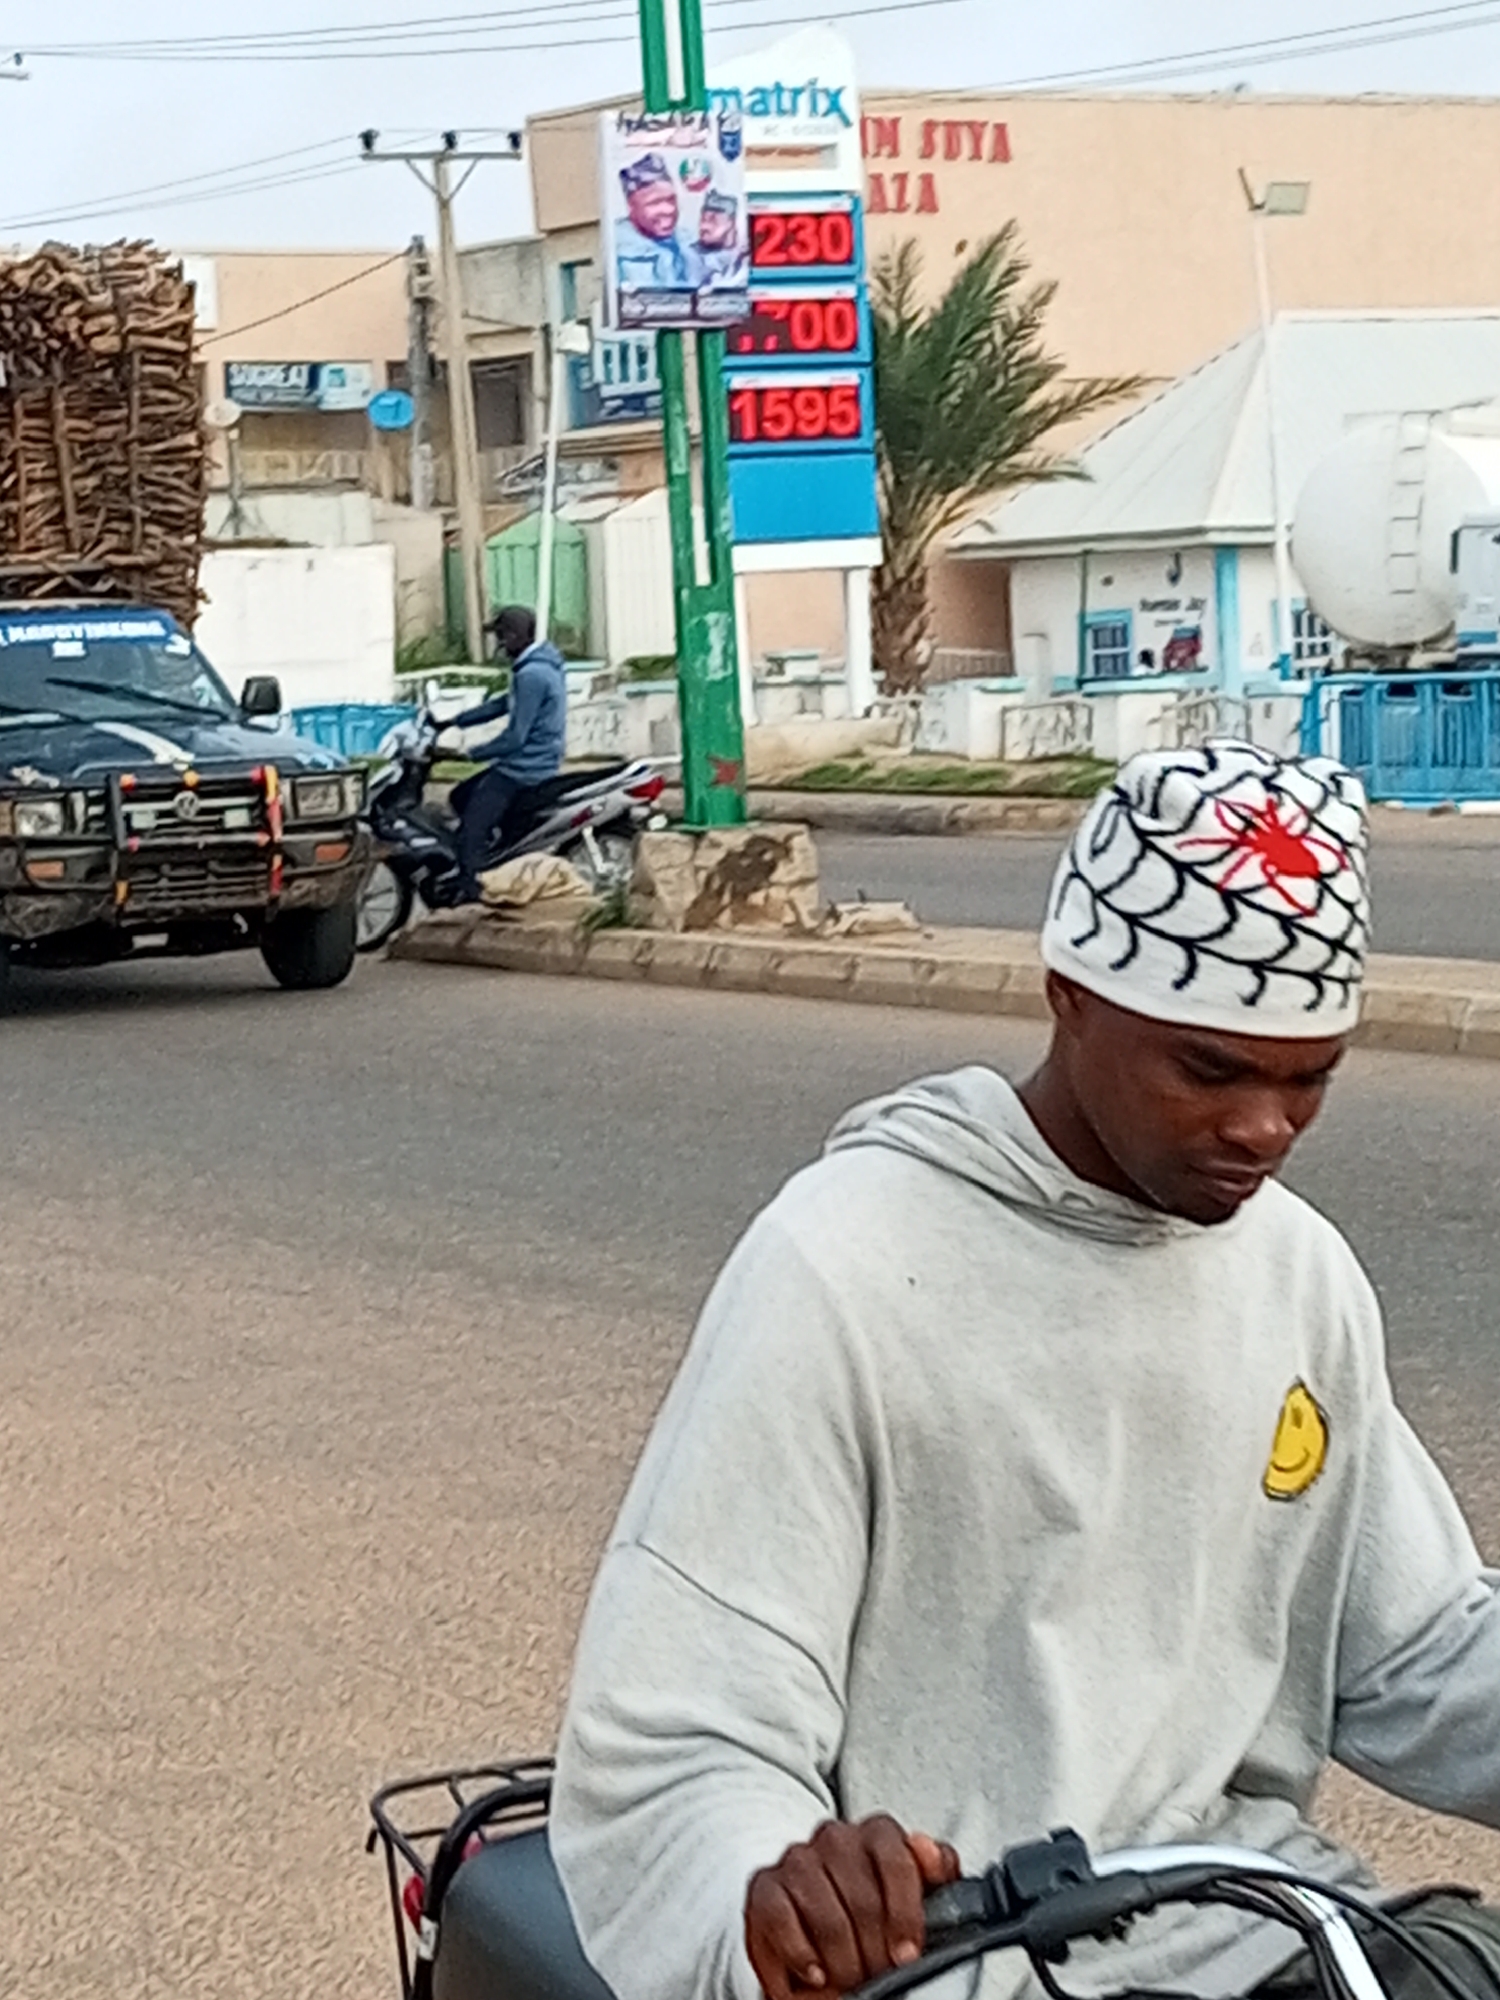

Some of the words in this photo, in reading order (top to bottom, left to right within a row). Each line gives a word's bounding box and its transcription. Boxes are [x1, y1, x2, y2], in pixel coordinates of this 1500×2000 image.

[705, 76, 853, 128] matrix
[919, 119, 1011, 163] SUYA
[753, 214, 853, 264] 230
[731, 387, 861, 440] 1595
